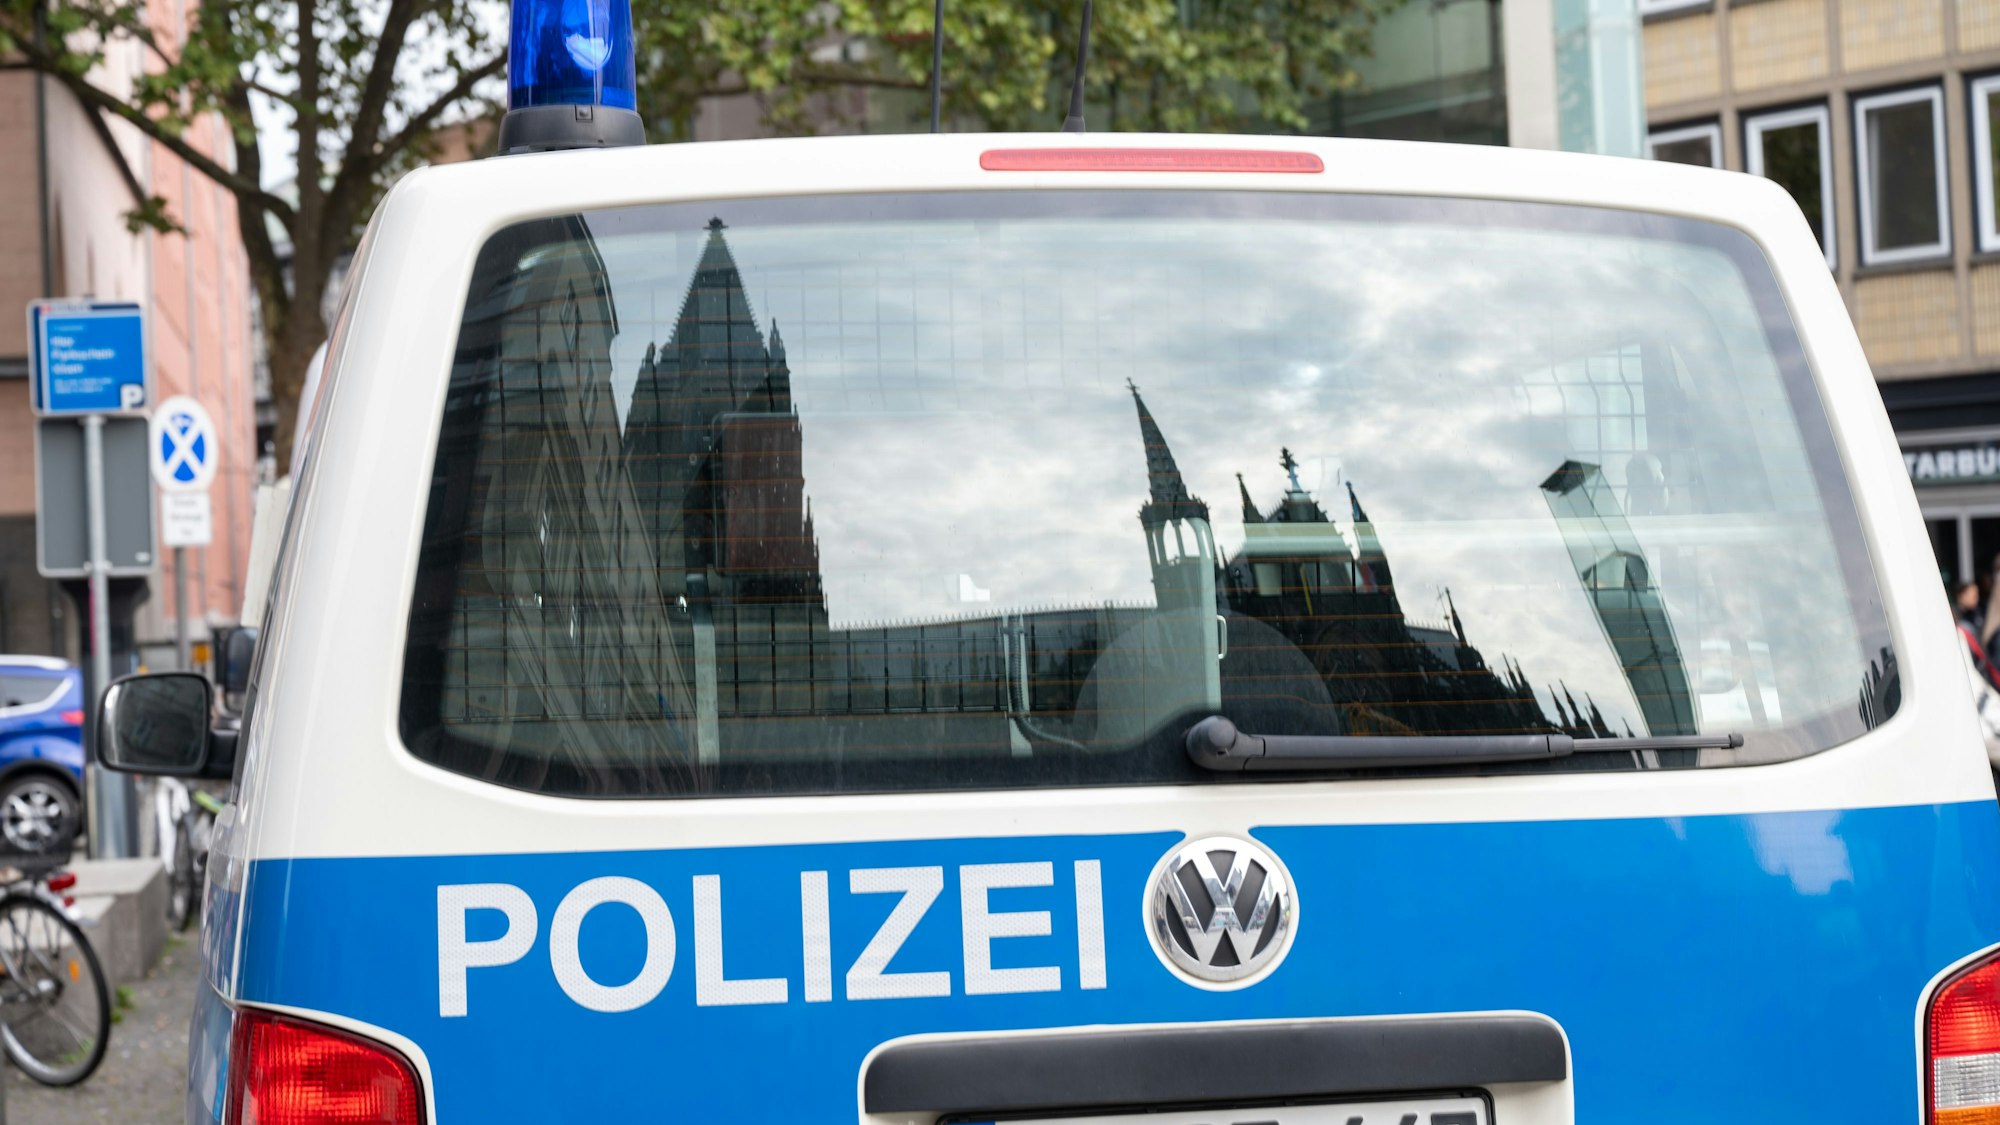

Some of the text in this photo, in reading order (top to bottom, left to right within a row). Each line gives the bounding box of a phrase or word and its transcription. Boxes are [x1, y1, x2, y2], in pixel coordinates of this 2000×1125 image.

[120, 384, 143, 409] P
[1903, 446, 2000, 479] TARBU
[437, 859, 1107, 1018] POLIZEI
[1153, 837, 1290, 981] VW
